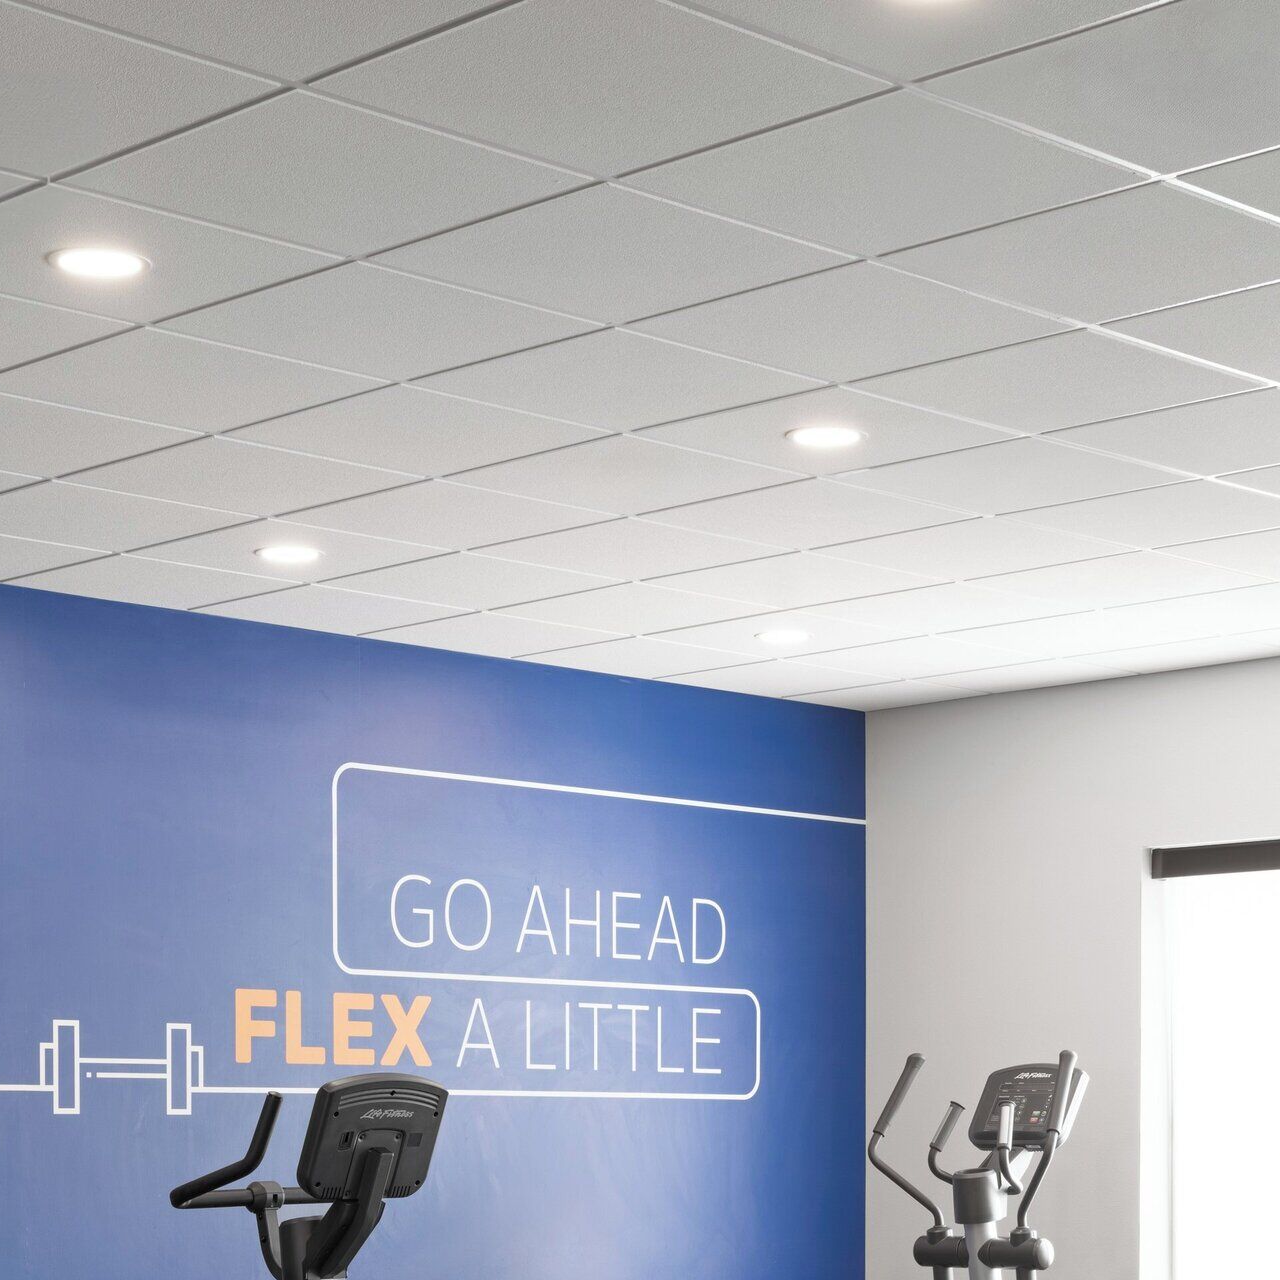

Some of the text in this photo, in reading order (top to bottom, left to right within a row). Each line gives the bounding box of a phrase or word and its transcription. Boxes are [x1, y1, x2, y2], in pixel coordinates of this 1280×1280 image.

[390, 874, 726, 965] GO AHEAD
[235, 988, 722, 1075] FLEX A LITTLE
